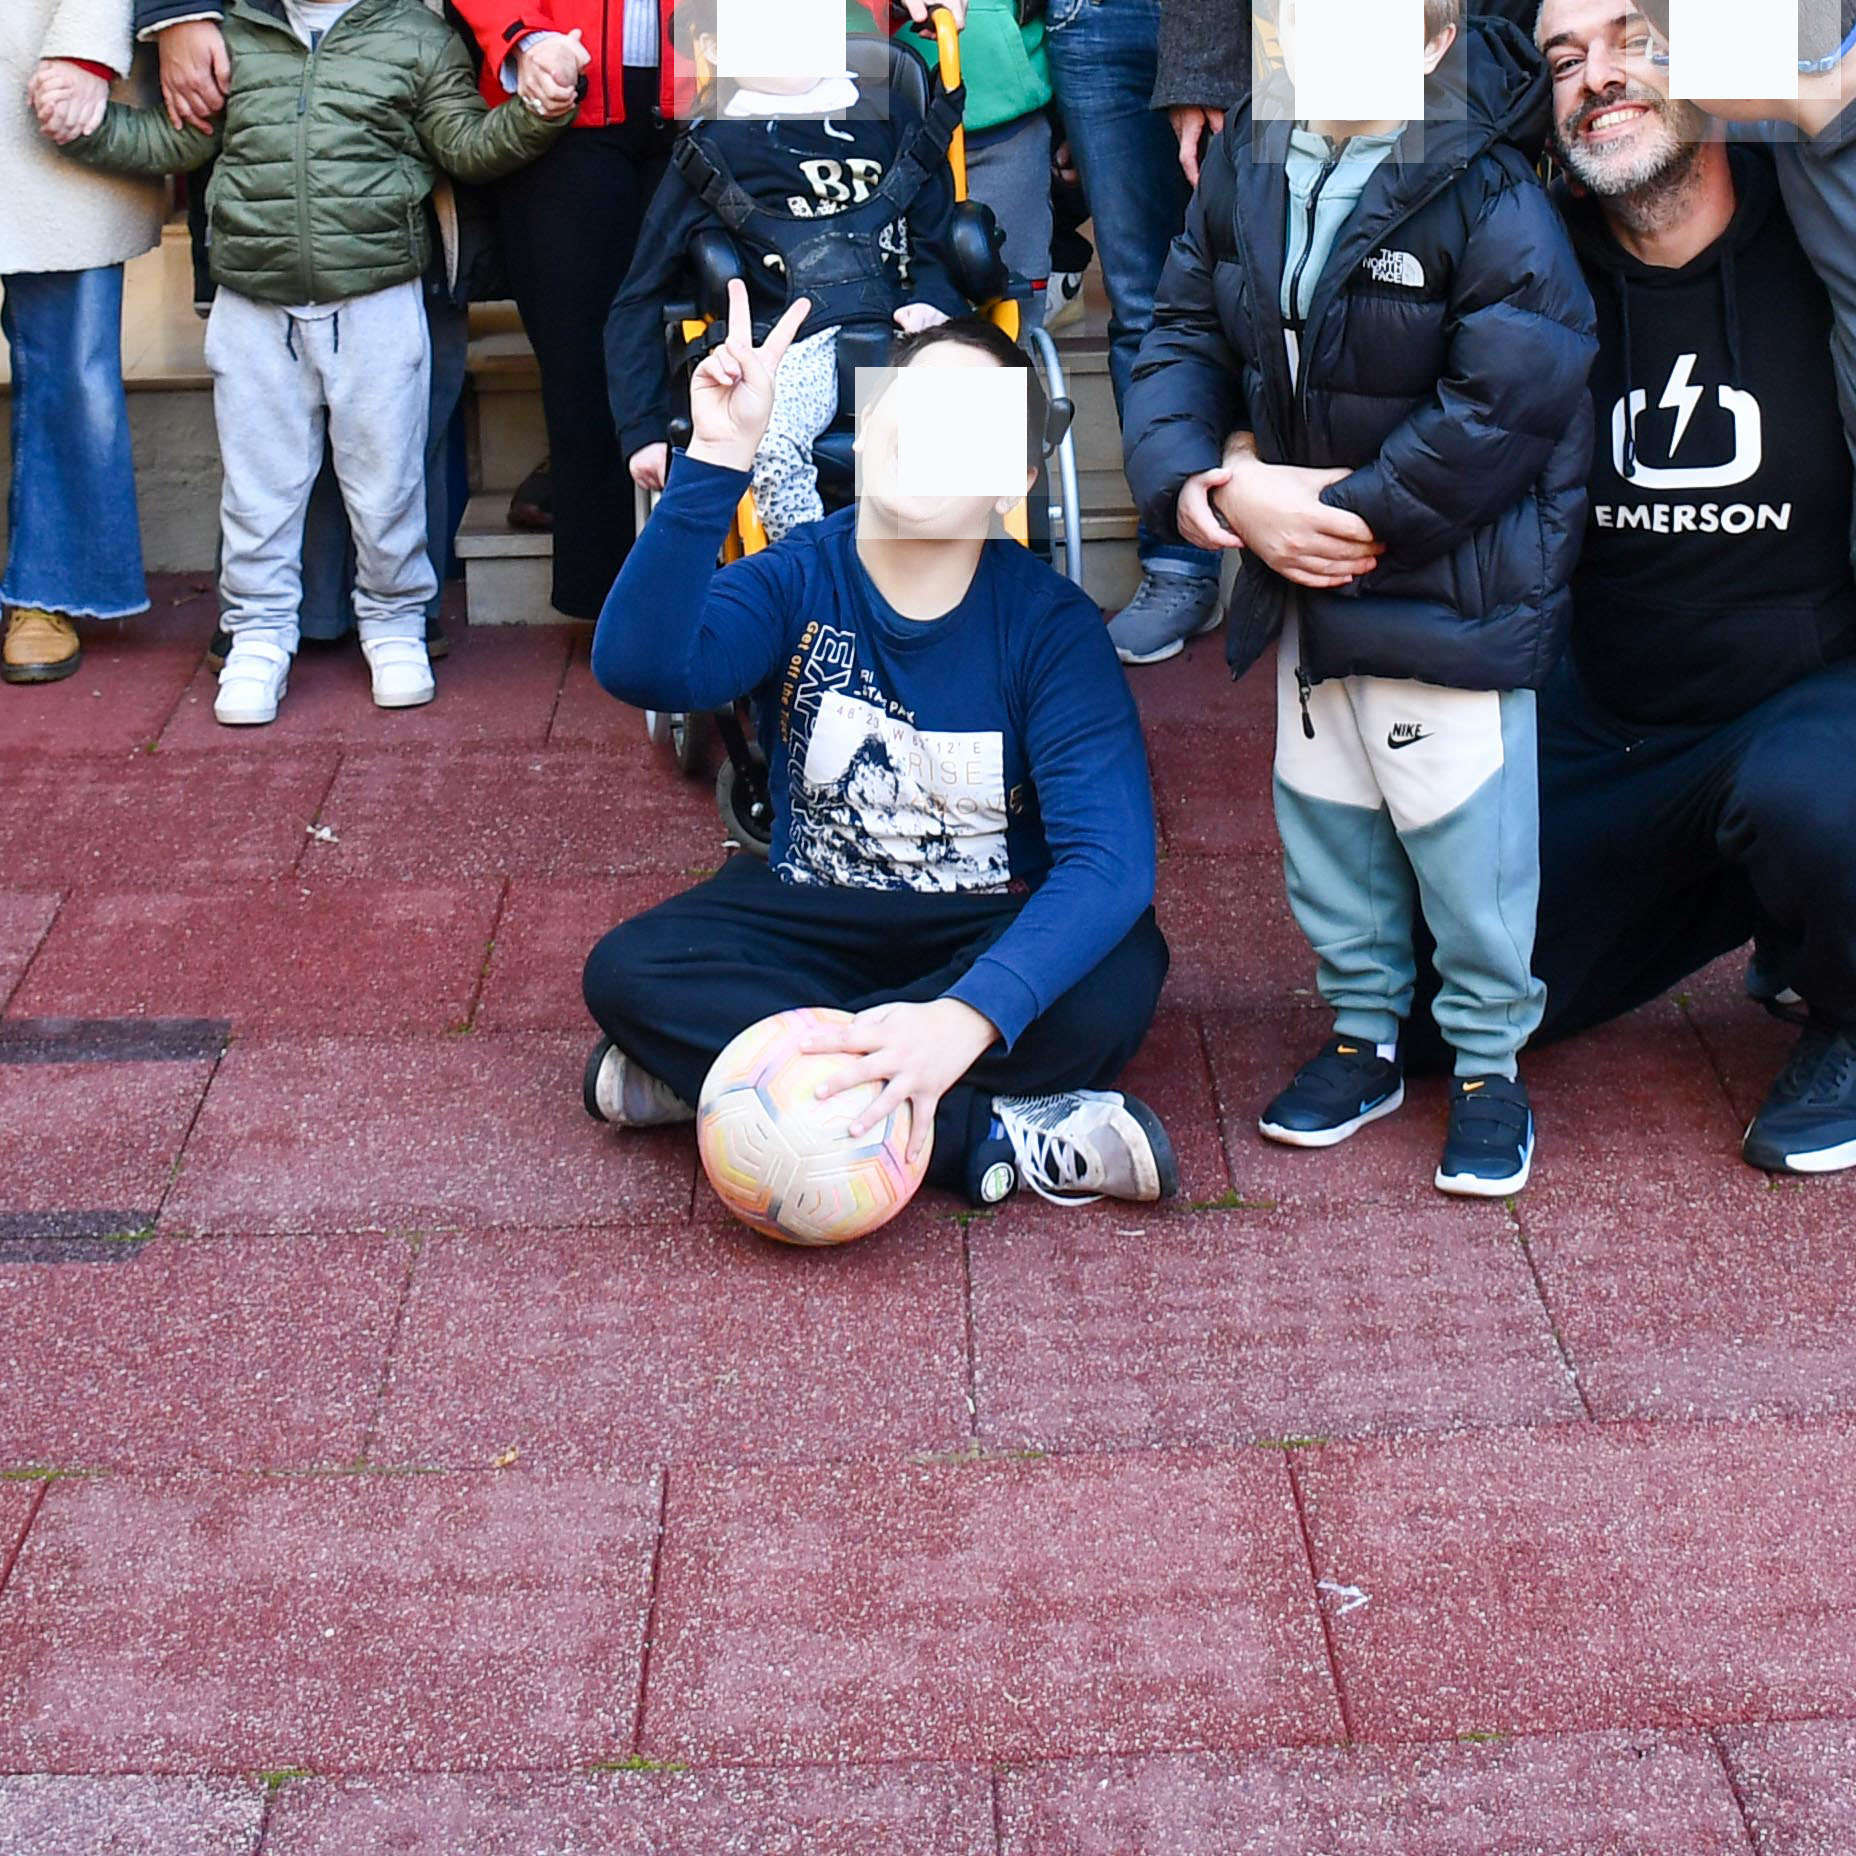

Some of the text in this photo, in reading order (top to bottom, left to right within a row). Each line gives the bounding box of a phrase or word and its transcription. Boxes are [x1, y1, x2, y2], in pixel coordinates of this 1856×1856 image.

[1380, 248, 1403, 263] THE
[1363, 257, 1403, 274] NORTH
[1372, 269, 1402, 284] FACE
[1595, 503, 1792, 534] EMERSON
[797, 620, 819, 652] Get
[1393, 723, 1422, 737] NIKE
[907, 751, 983, 786] RISE
